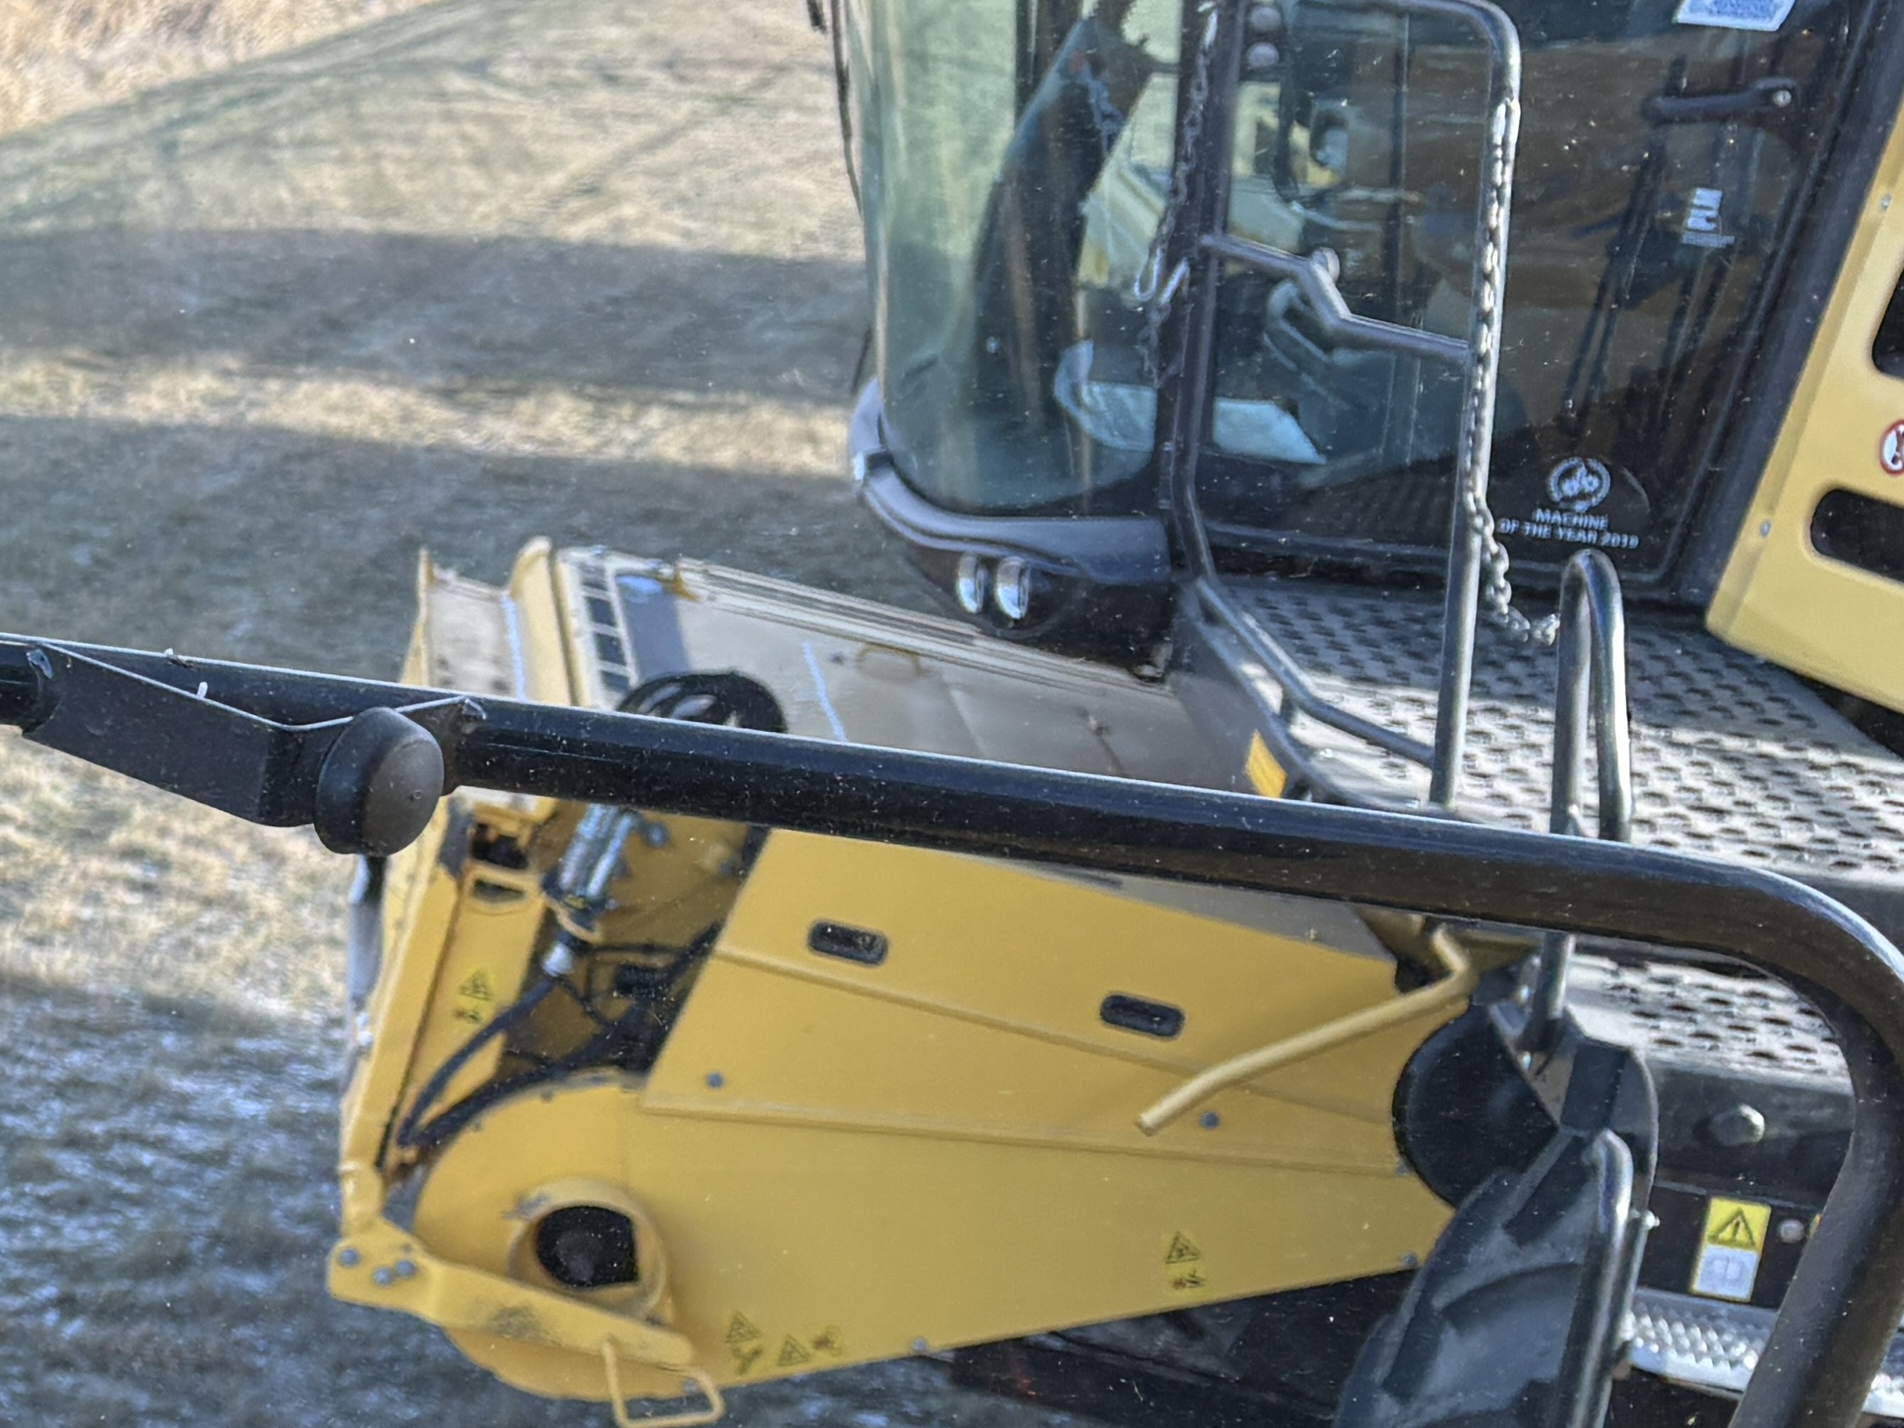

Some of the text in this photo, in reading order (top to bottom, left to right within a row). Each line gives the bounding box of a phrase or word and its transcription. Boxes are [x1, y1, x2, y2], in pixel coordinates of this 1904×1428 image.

[1499, 517, 1520, 535] OF
[1523, 522, 1552, 539] THE
[1556, 526, 1598, 544] YEAR
[1535, 508, 1608, 531] MACHINE
